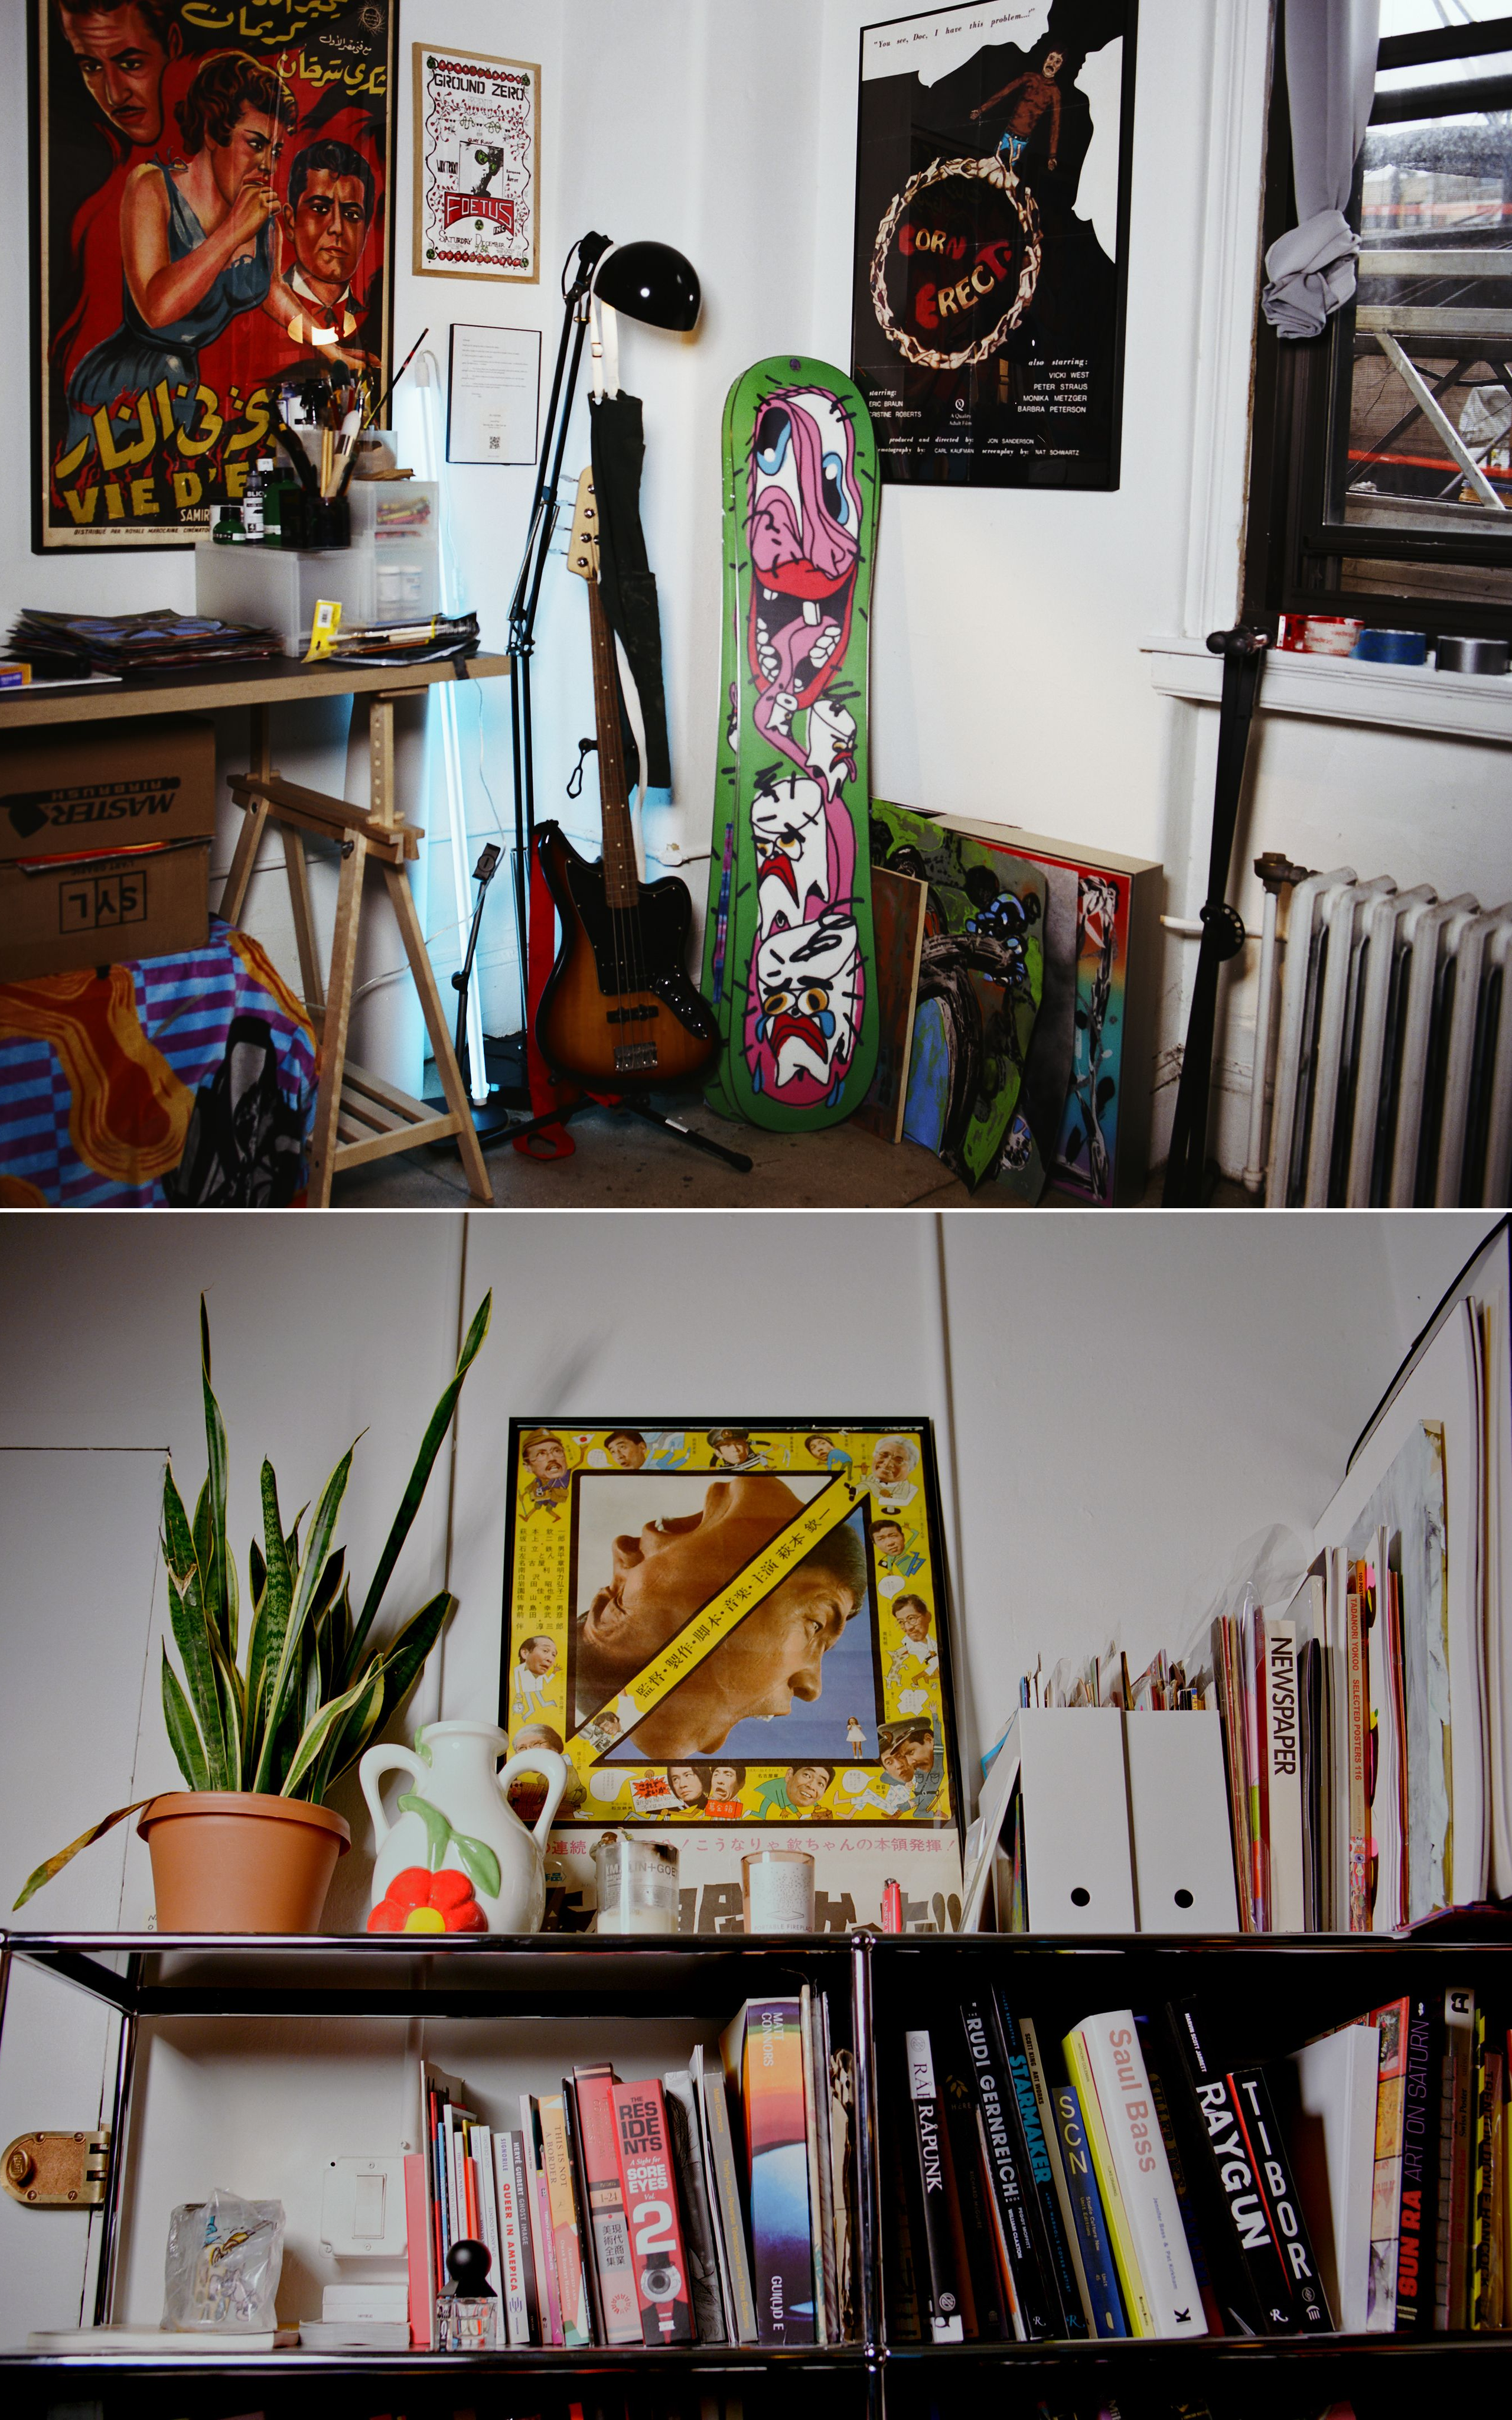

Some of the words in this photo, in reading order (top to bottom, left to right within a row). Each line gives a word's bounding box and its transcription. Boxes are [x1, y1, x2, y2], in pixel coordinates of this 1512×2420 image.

[946, 25, 962, 34] have
[969, 20, 984, 30] this
[434, 73, 485, 95] GROUND
[491, 83, 524, 101] ZERO
[447, 196, 513, 229] FOETUS
[439, 229, 472, 245] SATURDAY
[475, 233, 506, 248] DECEMBER
[915, 239, 1011, 329] ERECT
[982, 448, 1014, 457] screenplay
[63, 477, 160, 525] VIE
[51, 780, 162, 801] AIRBRUSH
[51, 793, 175, 826] MASTER
[69, 886, 138, 918] SYL
[1350, 1598, 1359, 1640] TADANORI
[1351, 1642, 1360, 1671] YOKOO
[1270, 1637, 1296, 1776] NEWSPAPER
[1352, 1679, 1361, 1722] SELECTED
[1353, 1724, 1362, 1764] POSTERS
[754, 1923, 785, 1932] PORTABLE
[786, 1924, 813, 1933] FIREPLACE
[762, 2012, 774, 2067] CONNORS
[773, 2012, 784, 2041] MATT
[1190, 2033, 1200, 2050] SCOTT
[1025, 2034, 1033, 2051] SCOTT
[1035, 2084, 1044, 2105] WORKS
[1109, 2028, 1142, 2091] Saul
[1407, 2019, 1430, 2099] SATURN
[619, 2102, 658, 2120] RES
[966, 2018, 992, 2067] RUDI
[979, 2074, 1020, 2198] GERNREICH
[1009, 2054, 1052, 2185] STARMAKER
[1406, 2105, 1425, 2135] ON
[621, 2117, 661, 2139] IDE
[1125, 2100, 1156, 2174] Bass
[513, 2142, 522, 2165] HERVÉ
[558, 2149, 564, 2162] IS
[624, 2137, 663, 2155] NTS
[636, 2158, 651, 2167] Sight
[651, 2156, 661, 2165] for
[918, 2104, 943, 2194] RÅPUNK
[1404, 2140, 1424, 2182] ART
[546, 2140, 557, 2184] BORDER
[559, 2167, 568, 2187] NOT
[627, 2164, 666, 2181] SORE
[1195, 2081, 1272, 2250] RAYGUN
[514, 2167, 524, 2195] GUIBERT
[628, 2177, 668, 2194] EYES
[1241, 2080, 1312, 2280] TIBOR
[503, 2183, 513, 2219] QUEER
[519, 2198, 527, 2221] GHOST
[644, 2193, 656, 2201] Vol.
[1401, 2190, 1422, 2231] RA
[506, 2224, 514, 2236] IN
[520, 2223, 529, 2245] IMAGE
[632, 2200, 677, 2255] 2
[1397, 2235, 1420, 2298] SUN
[1174, 2307, 1191, 2323] K
